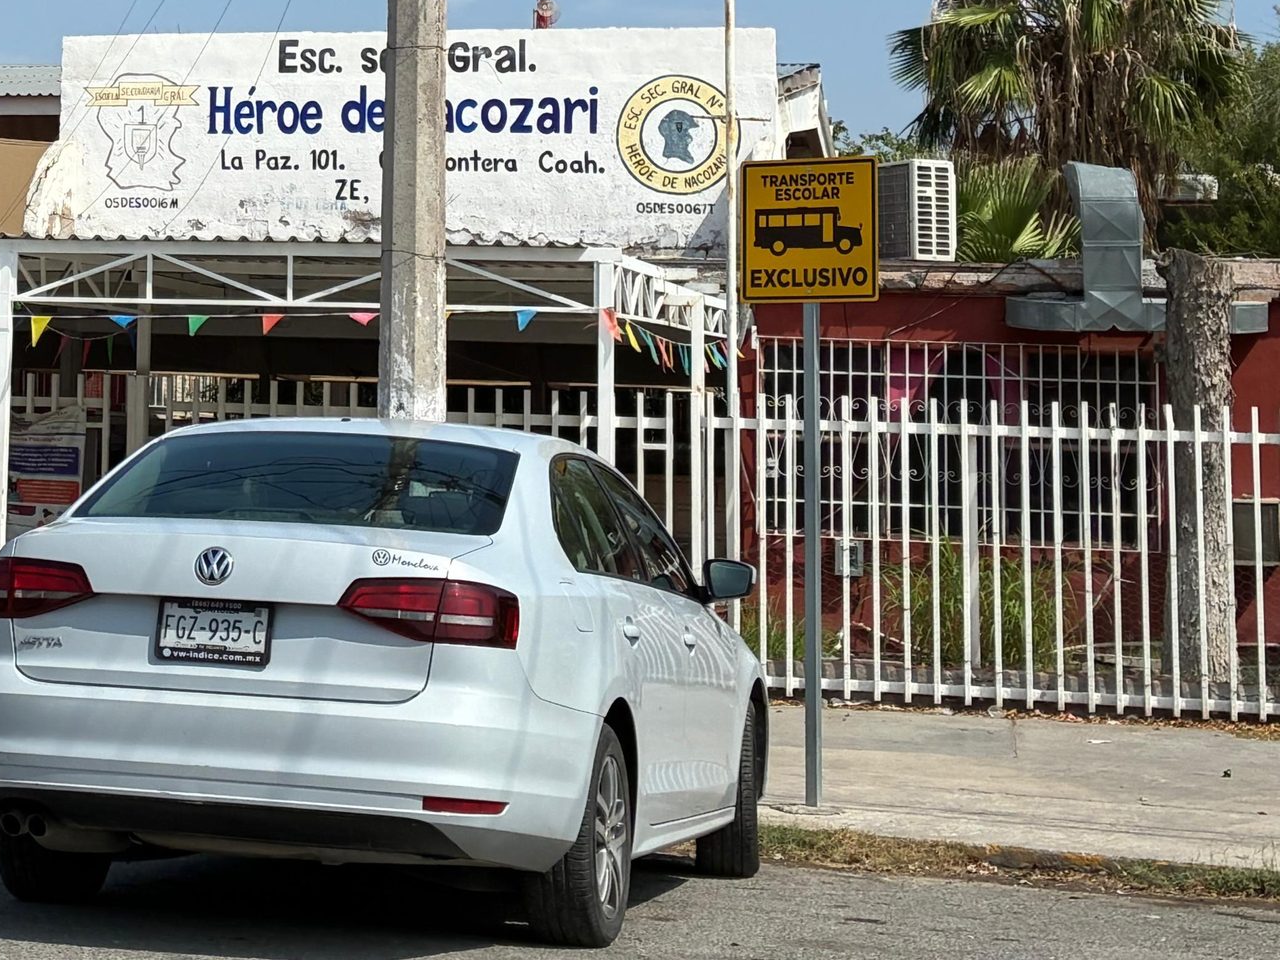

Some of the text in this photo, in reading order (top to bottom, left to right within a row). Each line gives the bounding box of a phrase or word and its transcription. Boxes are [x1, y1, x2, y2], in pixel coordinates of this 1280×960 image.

[278, 39, 342, 74] Esc.
[448, 39, 537, 73] Gral.
[671, 80, 702, 100] GRAL
[207, 85, 323, 135] Héroe
[341, 85, 386, 134] de
[220, 149, 606, 174] La Paz. 101. ontera Coah.
[625, 143, 658, 182] HEROE
[662, 176, 679, 189] DE
[761, 172, 854, 188] TRANSPORTE
[775, 187, 840, 201] ESCOLAR
[750, 266, 868, 288] EXCLUSIVO
[163, 614, 264, 645] FGZ-935-C
[172, 650, 261, 663] vw-indice.com.mx
